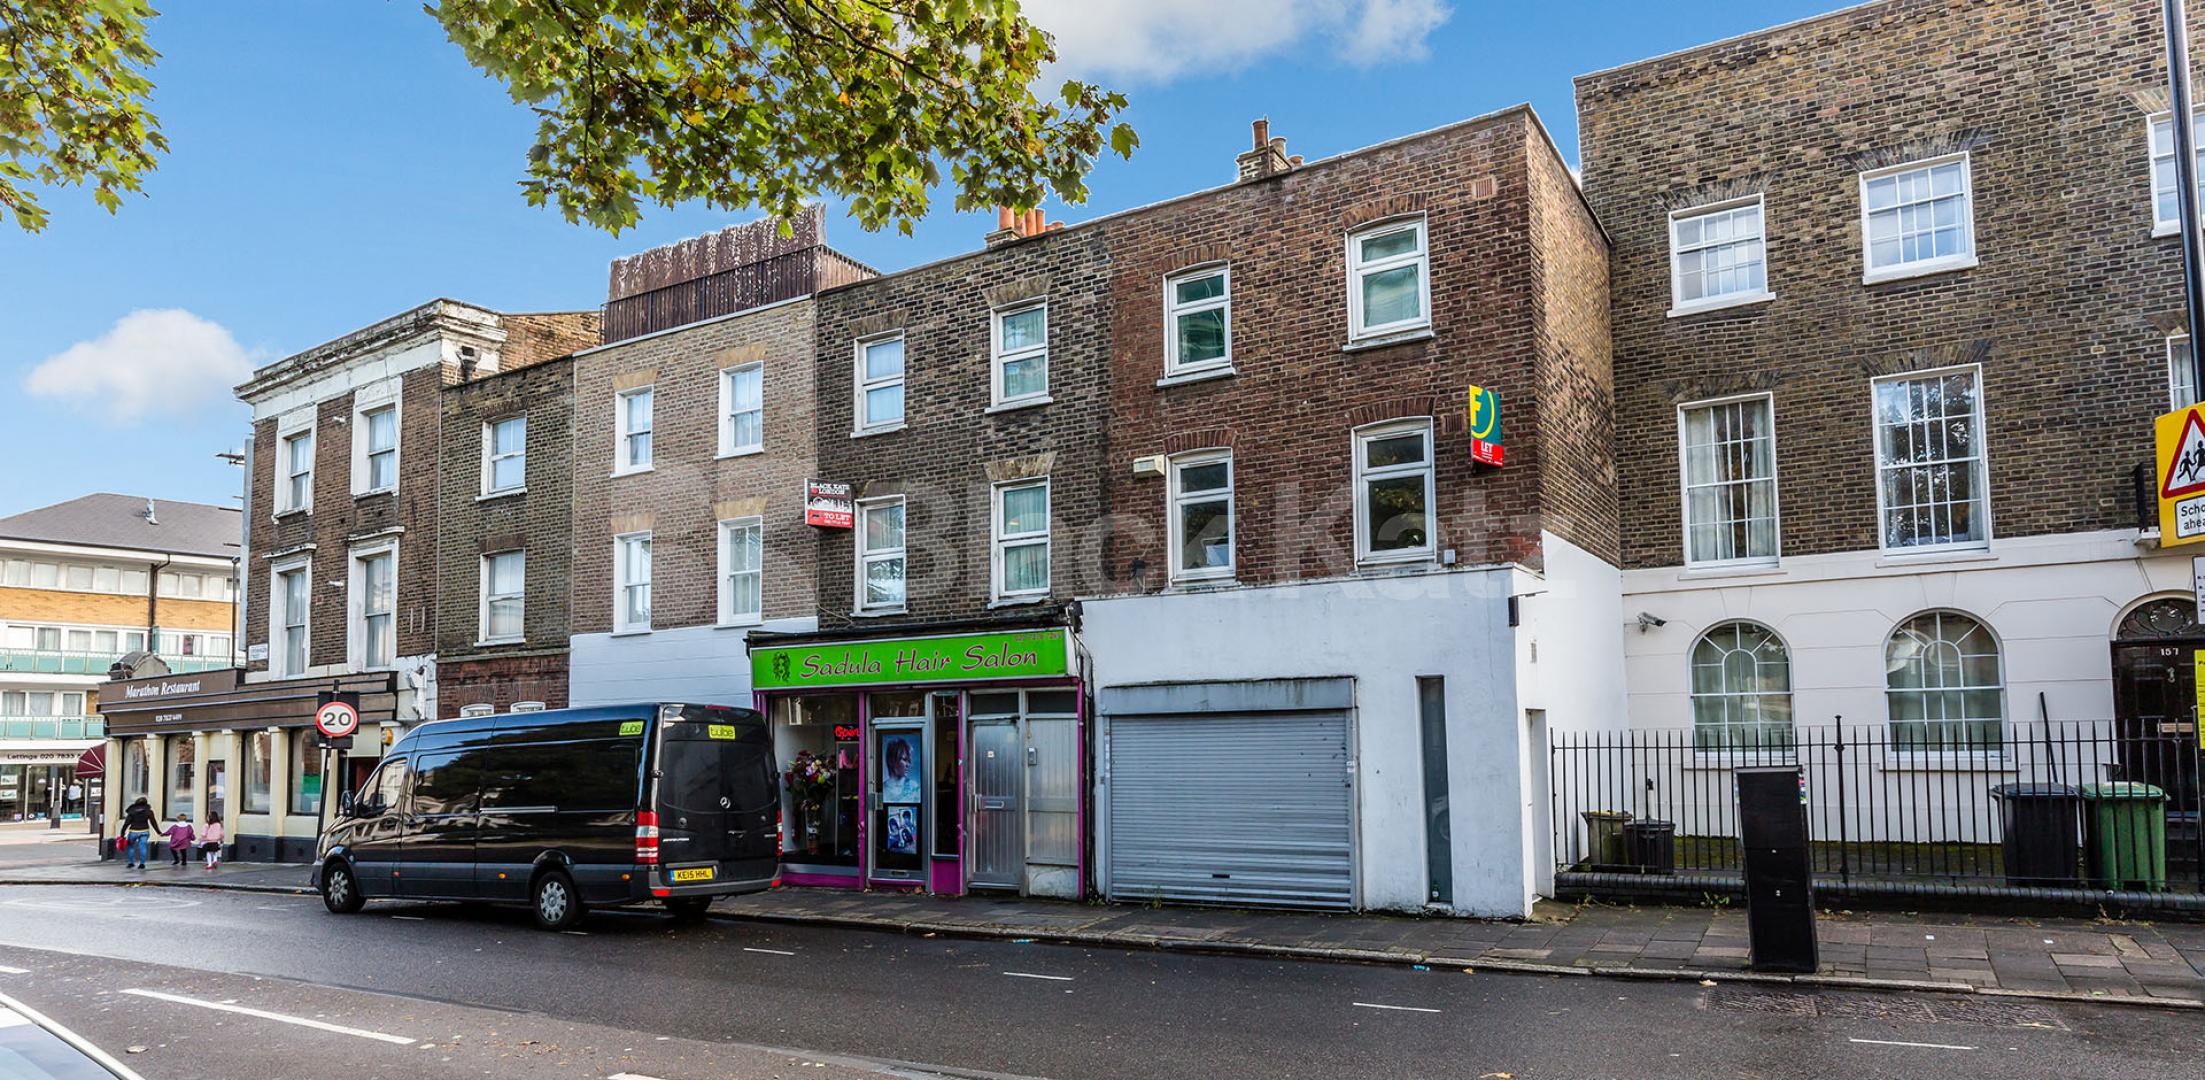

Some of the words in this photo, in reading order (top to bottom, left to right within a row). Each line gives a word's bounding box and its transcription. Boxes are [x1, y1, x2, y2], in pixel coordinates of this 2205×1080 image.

[1481, 440, 1493, 453] LET
[824, 512, 834, 520] TO
[2161, 647, 2178, 656] 157
[800, 650, 881, 678] Sadula
[895, 648, 951, 673] Hair
[961, 642, 1037, 670] Salon
[125, 684, 160, 699] Marathon
[161, 680, 201, 696] Restaurant
[324, 712, 352, 726] 20
